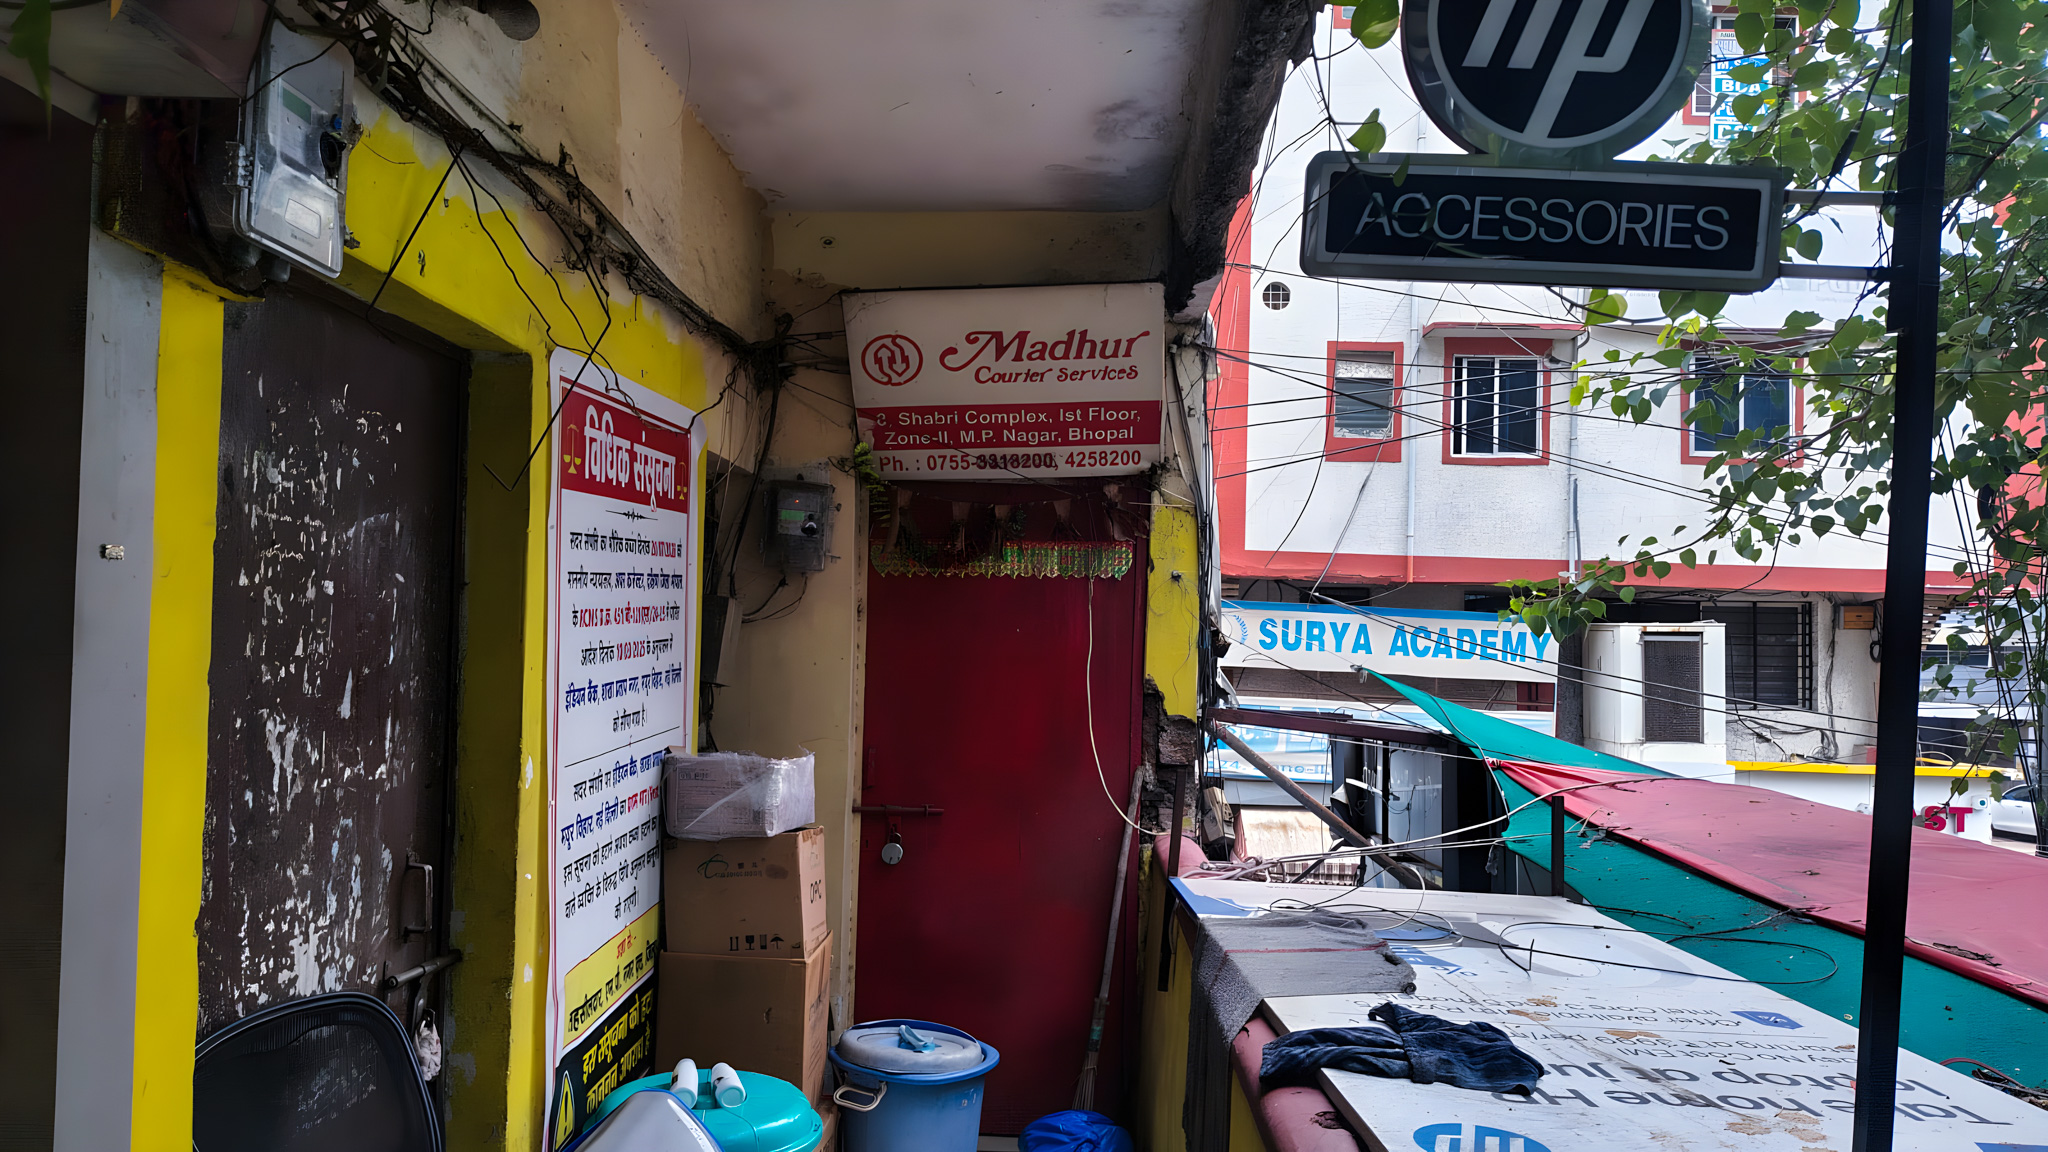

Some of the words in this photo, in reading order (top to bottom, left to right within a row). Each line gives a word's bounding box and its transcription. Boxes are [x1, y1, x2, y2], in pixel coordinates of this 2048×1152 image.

[1355, 191, 1731, 251] ACCESSORIES
[939, 328, 1151, 372] Madhur
[973, 364, 1053, 385] Courier
[1056, 364, 1139, 383] Services
[898, 411, 959, 426] Shabri
[964, 408, 1053, 427] Complex,
[1088, 406, 1141, 422] Floor,
[960, 429, 996, 443] M.P.
[1003, 428, 1062, 445] Nagar,
[1068, 426, 1134, 443] Bhopal
[584, 405, 631, 488] विधिक
[1064, 449, 1142, 468] 4258200
[1258, 617, 1373, 655] SURYA
[1388, 624, 1551, 664] ACADEMY
[1912, 805, 1973, 832] ST
[563, 862, 573, 888] इस
[1588, 1003, 1657, 1014] Core
[1657, 1005, 1722, 1017] Intel
[1666, 1016, 1739, 1027] Offer
[582, 1043, 598, 1085] इस
[629, 993, 640, 1030] को
[1616, 1047, 1678, 1058] EMI
[1677, 1049, 1754, 1061] Cost
[1757, 1052, 1807, 1064] No
[1807, 1054, 1858, 1064] asy
[1543, 1062, 1621, 1082] ju
[1619, 1066, 1700, 1083] at
[1603, 1090, 1825, 1117] home
